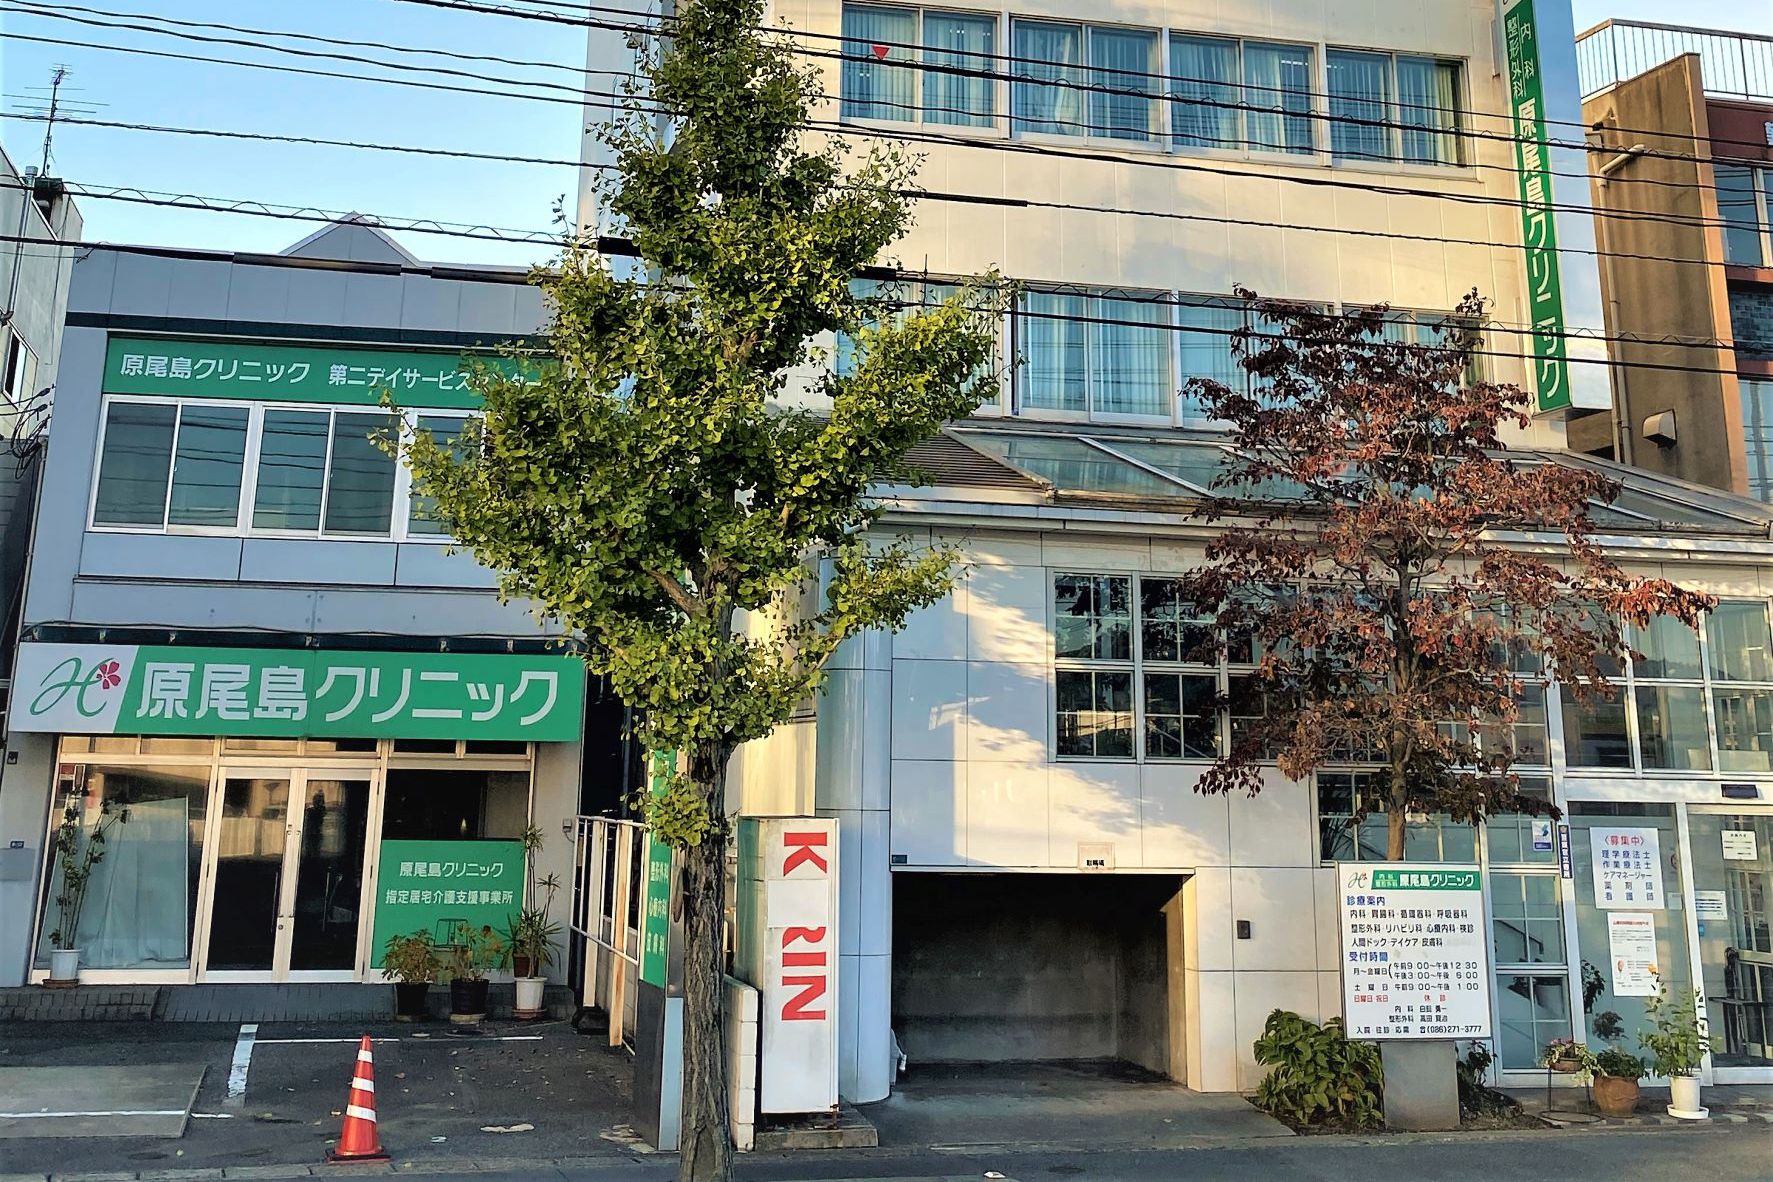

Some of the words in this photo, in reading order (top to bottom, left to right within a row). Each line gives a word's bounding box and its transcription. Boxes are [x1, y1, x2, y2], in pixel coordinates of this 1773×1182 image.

[1507, 16, 1523, 99] 整形外科
[1521, 22, 1535, 79] 内科
[120, 353, 310, 384] 原尾島クリニック
[136, 662, 558, 726] 原尾島クリニック
[1602, 850, 1650, 859] 理学療法士
[400, 862, 503, 877] 原尾島クリニック
[1603, 861, 1651, 870] 作業療法士
[1400, 874, 1474, 887] 原尾島クリニック
[1603, 871, 1652, 879] ケアマネージャー
[386, 890, 513, 905] 指定居宅介護支援事業所
[1347, 896, 1386, 906] 診療案内
[782, 832, 827, 1020] KRIN
[1349, 952, 1388, 962] 受付時間
